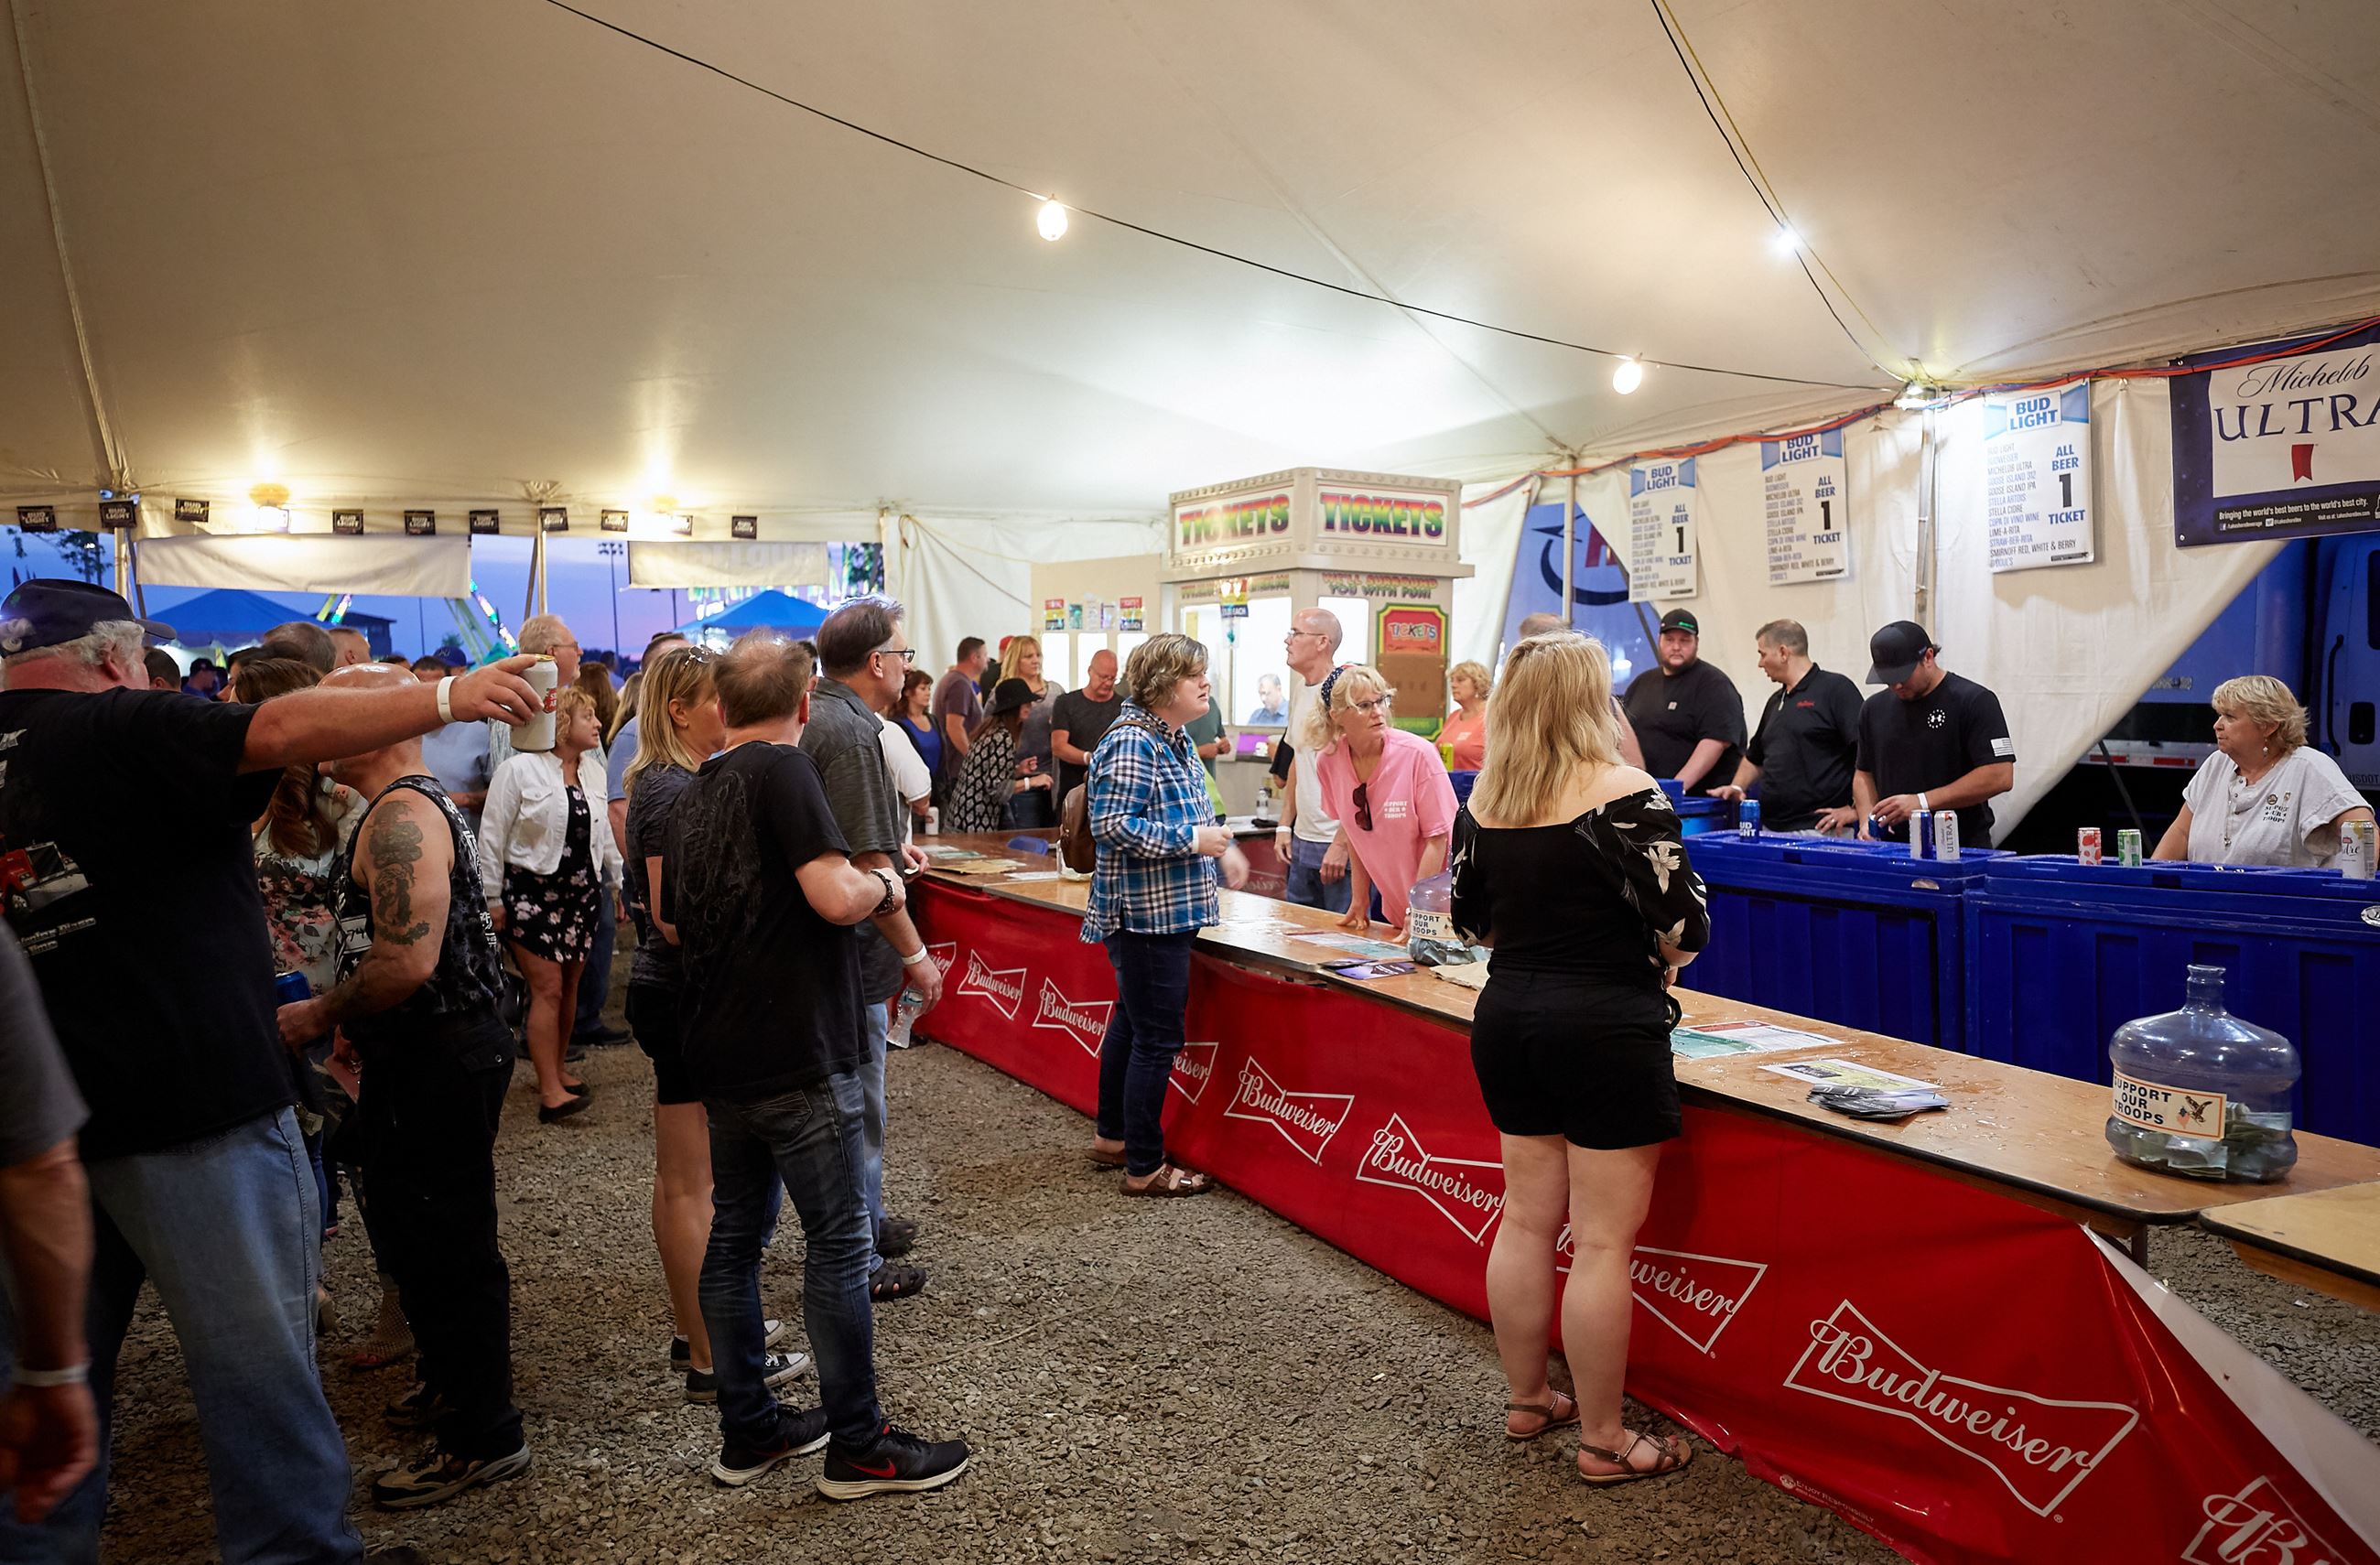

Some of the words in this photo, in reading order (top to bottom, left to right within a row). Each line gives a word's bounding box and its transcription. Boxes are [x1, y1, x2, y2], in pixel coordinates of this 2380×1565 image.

[2237, 354, 2373, 397] Michelob
[2016, 397, 2050, 416] BUD
[2009, 409, 2058, 430] LIGHT
[1787, 435, 1813, 449] BUD
[1781, 446, 1819, 462] LIGHT
[2056, 444, 2074, 457] ALL
[1988, 464, 2015, 475] MICHELOB
[2016, 461, 2032, 472] ULTRA
[2051, 457, 2079, 471] BEER
[1650, 466, 1672, 479] BUD
[2007, 472, 2026, 482] ISLAND
[2027, 470, 2036, 480] 312
[1647, 476, 1677, 491] LIGHT
[1818, 476, 1832, 487] ALL
[1988, 486, 2005, 496] GOOSE
[2007, 483, 2026, 493] ISLAND
[2028, 481, 2036, 490] IPA
[1815, 487, 1835, 499] BEER
[2059, 473, 2072, 508] 1
[1988, 496, 2006, 507] STELLA
[2007, 493, 2027, 503] ARTOIS
[181, 506, 204, 514] LIGHT
[1320, 491, 1444, 539] TICKETS
[1674, 503, 1686, 513] ALL
[1821, 501, 1831, 530] 1
[1988, 507, 2007, 517] STELLA
[2219, 510, 2242, 521] Bringing
[2253, 506, 2274, 517] world's
[2275, 505, 2288, 514] best
[2288, 504, 2303, 513] beers
[2304, 503, 2310, 512] to
[2310, 502, 2320, 511] the
[2320, 501, 2342, 510] world's
[2342, 499, 2355, 508] best
[2355, 498, 2368, 508] city.
[1180, 494, 1291, 546] TICKETS
[1671, 513, 1689, 524] BEER
[2010, 514, 2024, 523] VINO
[2025, 513, 2039, 522] WINE
[2049, 510, 2085, 524] TICKET
[1989, 525, 2020, 537] LIME-A-RITA
[1676, 526, 1684, 554] 1
[1813, 533, 1841, 545] TICKET
[1989, 534, 2032, 547] STRAW-BER-RITA
[1990, 546, 2017, 557] SMIRNOFF
[2031, 543, 2049, 552] WHITE
[2050, 541, 2056, 550] &
[2058, 539, 2076, 549] BERRY
[1669, 556, 1692, 567] TICKET
[1329, 583, 1358, 595] YOU
[1361, 585, 1397, 598] WITH
[1388, 622, 1437, 640] TICKETS
[1739, 821, 1753, 829] UD
[1946, 825, 1954, 854] ULTRA
[1414, 920, 1428, 928] OUR
[968, 960, 1022, 1000] Budweiser
[1039, 987, 1107, 1036] Budweiser
[1239, 1070, 1336, 1138] Budweiser
[2121, 1092, 2147, 1109] OUR
[2115, 1099, 2164, 1125] TROOPS
[1373, 1128, 1502, 1213] Budweiser
[1810, 1319, 2093, 1473] Budweiser
